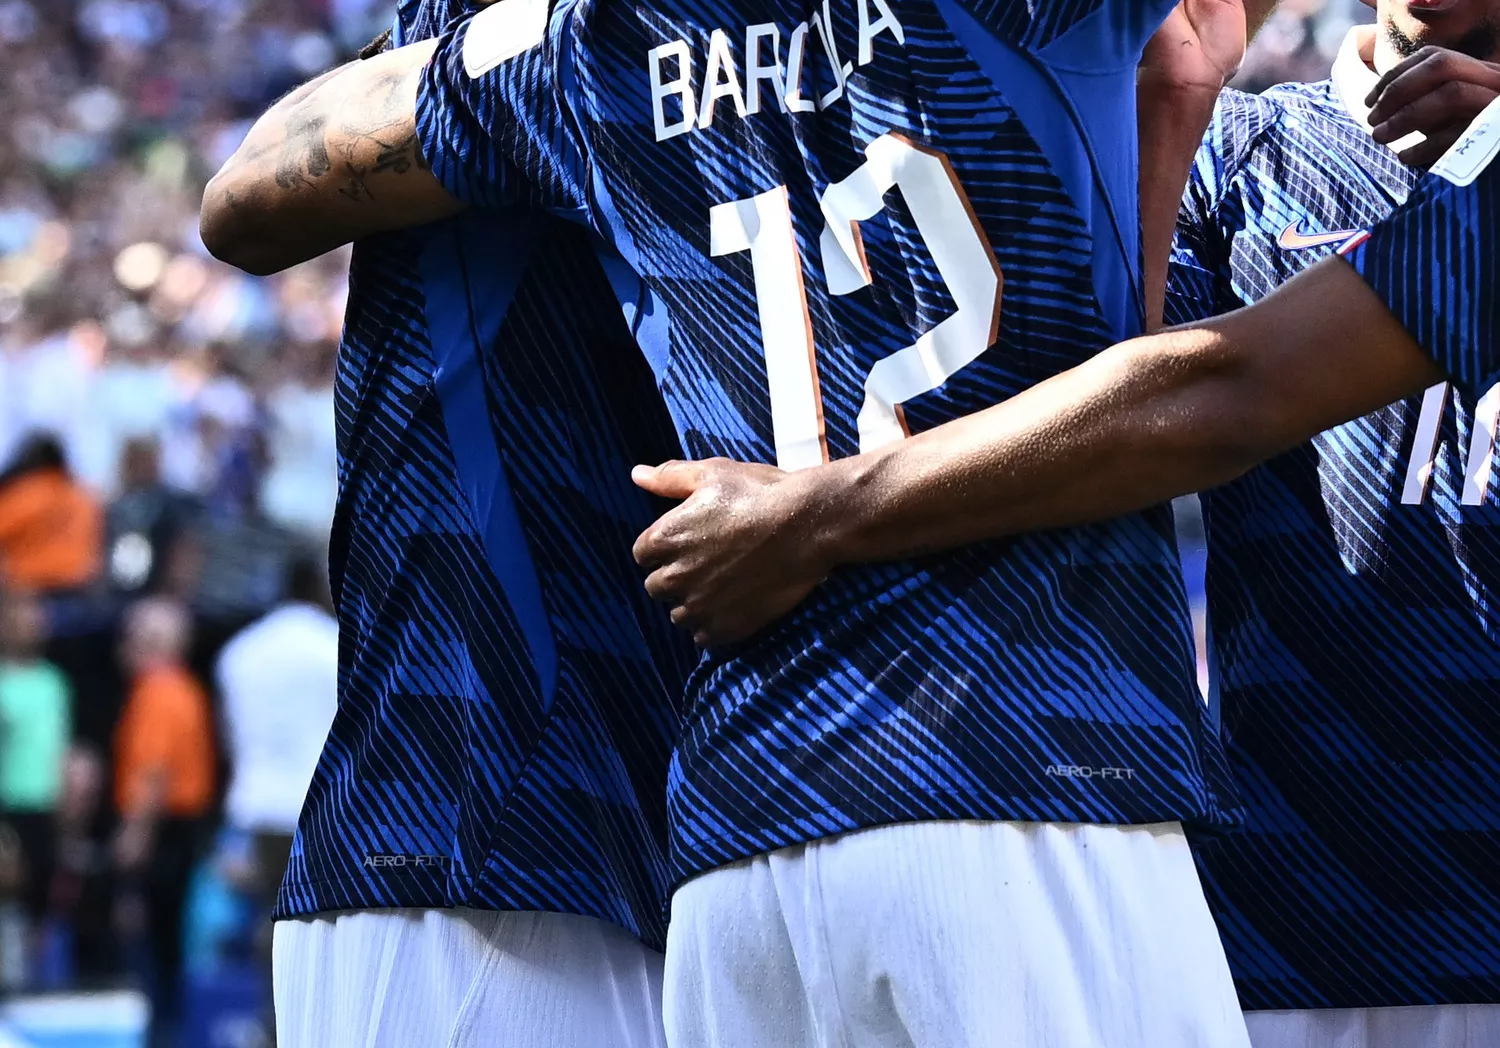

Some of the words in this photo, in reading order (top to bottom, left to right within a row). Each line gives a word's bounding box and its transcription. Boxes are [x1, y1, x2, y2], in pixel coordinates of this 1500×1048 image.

[709, 131, 1004, 473] 12
[1045, 764, 1135, 780] AERO-FIT
[363, 854, 449, 867] AERO-FIT
